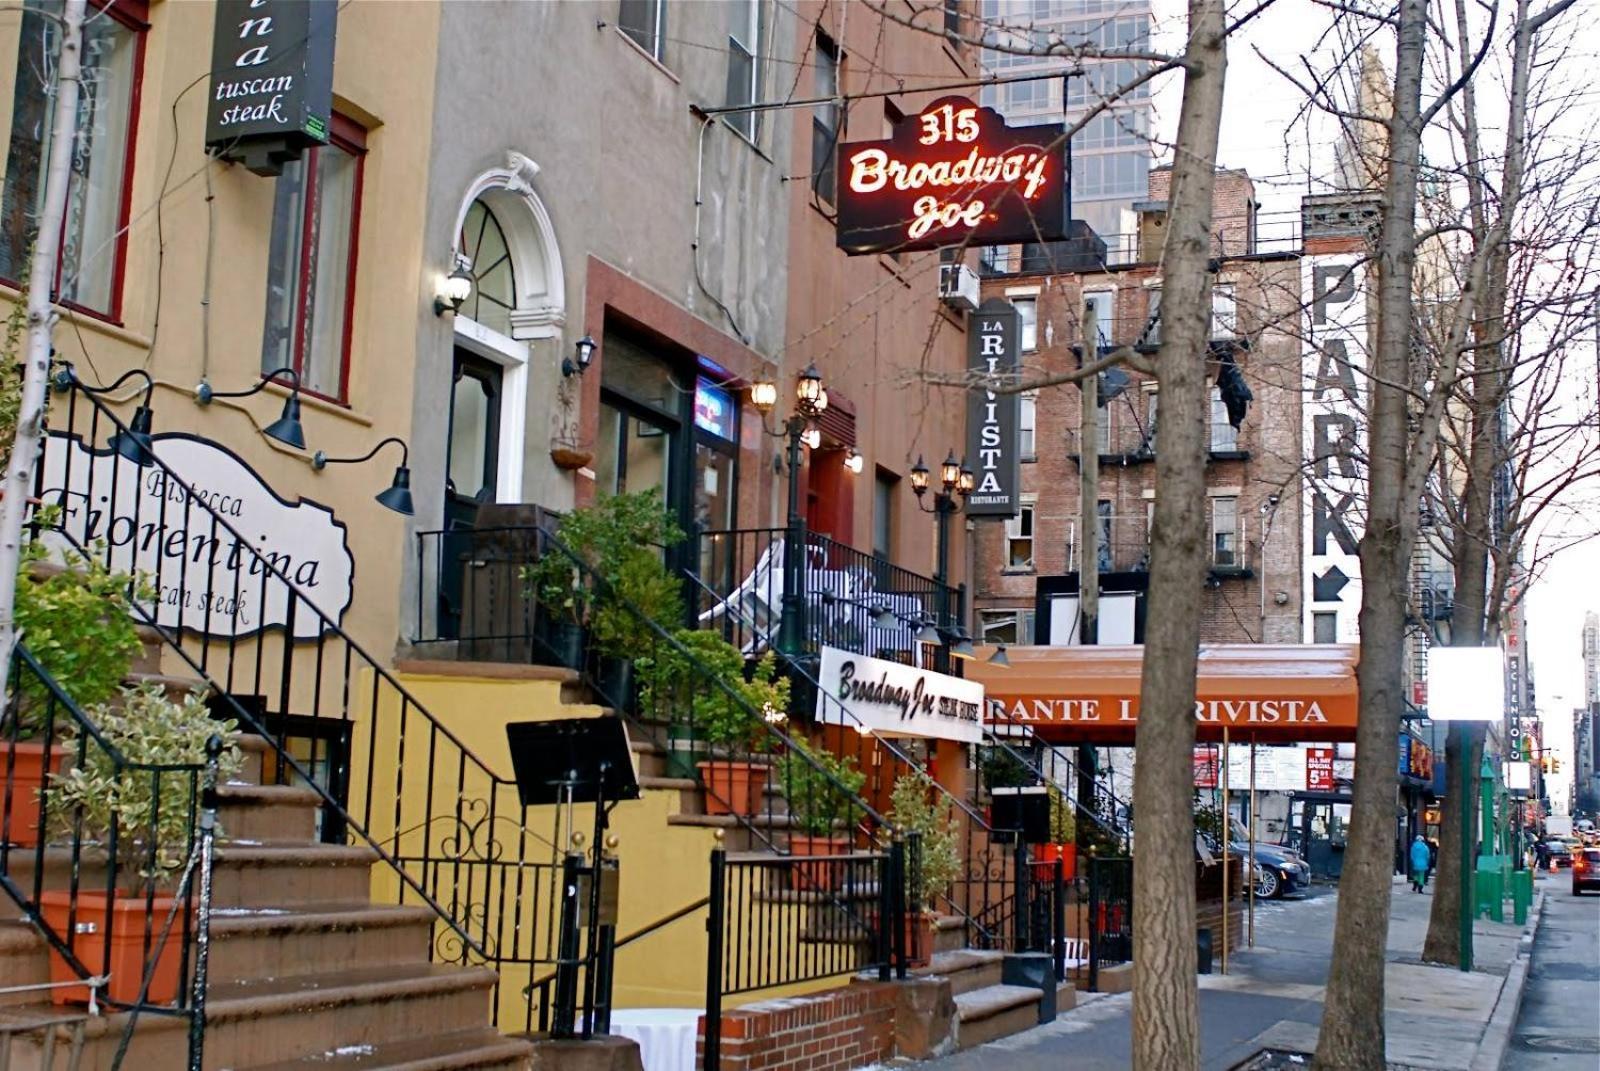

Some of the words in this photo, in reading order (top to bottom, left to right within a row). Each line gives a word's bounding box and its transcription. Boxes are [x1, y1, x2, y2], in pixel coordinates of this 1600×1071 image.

[215, 73, 292, 100] tuscan
[220, 95, 288, 124] steak
[919, 105, 980, 145] 315
[850, 146, 1048, 198] Broadway
[908, 196, 986, 238] Joe
[982, 321, 1004, 332] LA
[1313, 265, 1359, 555] PARK
[39, 488, 320, 587] Fiorentina
[198, 590, 249, 625] steak
[839, 661, 911, 721] Broadway
[909, 677, 936, 720] Joe
[984, 699, 1100, 721] RANTE
[1119, 700, 1139, 721] L
[1510, 660, 1520, 760] SCIENTOLO
